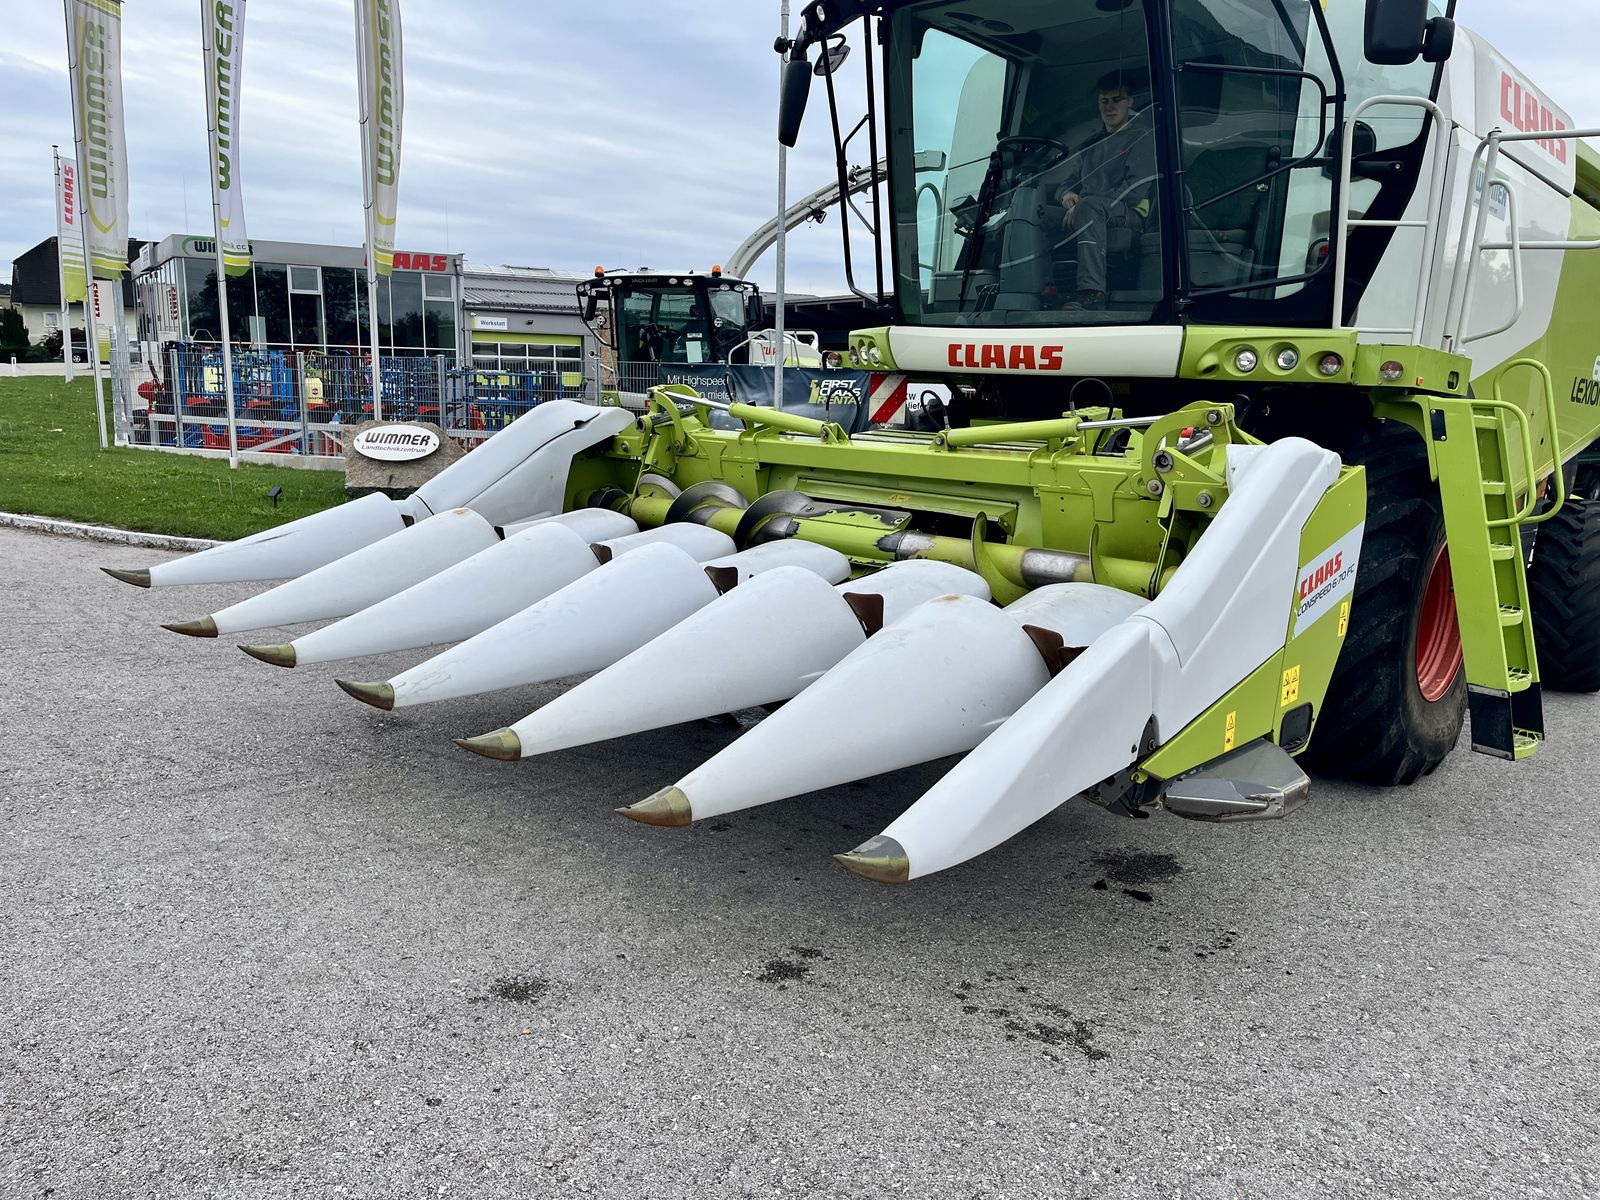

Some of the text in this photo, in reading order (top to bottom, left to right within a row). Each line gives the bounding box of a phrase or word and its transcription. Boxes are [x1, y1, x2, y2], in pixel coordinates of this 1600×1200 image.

[85, 21, 108, 199] WIMMER
[215, 0, 234, 190] WIMMER
[1500, 71, 1567, 166] CLAAS
[64, 164, 74, 225] CLAAS
[948, 343, 1064, 371] CLAAS
[667, 374, 729, 388] Mit Highspeed
[820, 379, 857, 388] FIRST
[1570, 376, 1600, 407] LEXIO
[361, 444, 427, 454] Landtechnikzentrum
[365, 432, 431, 447] WIMMER
[1300, 550, 1343, 601] CLAAS
